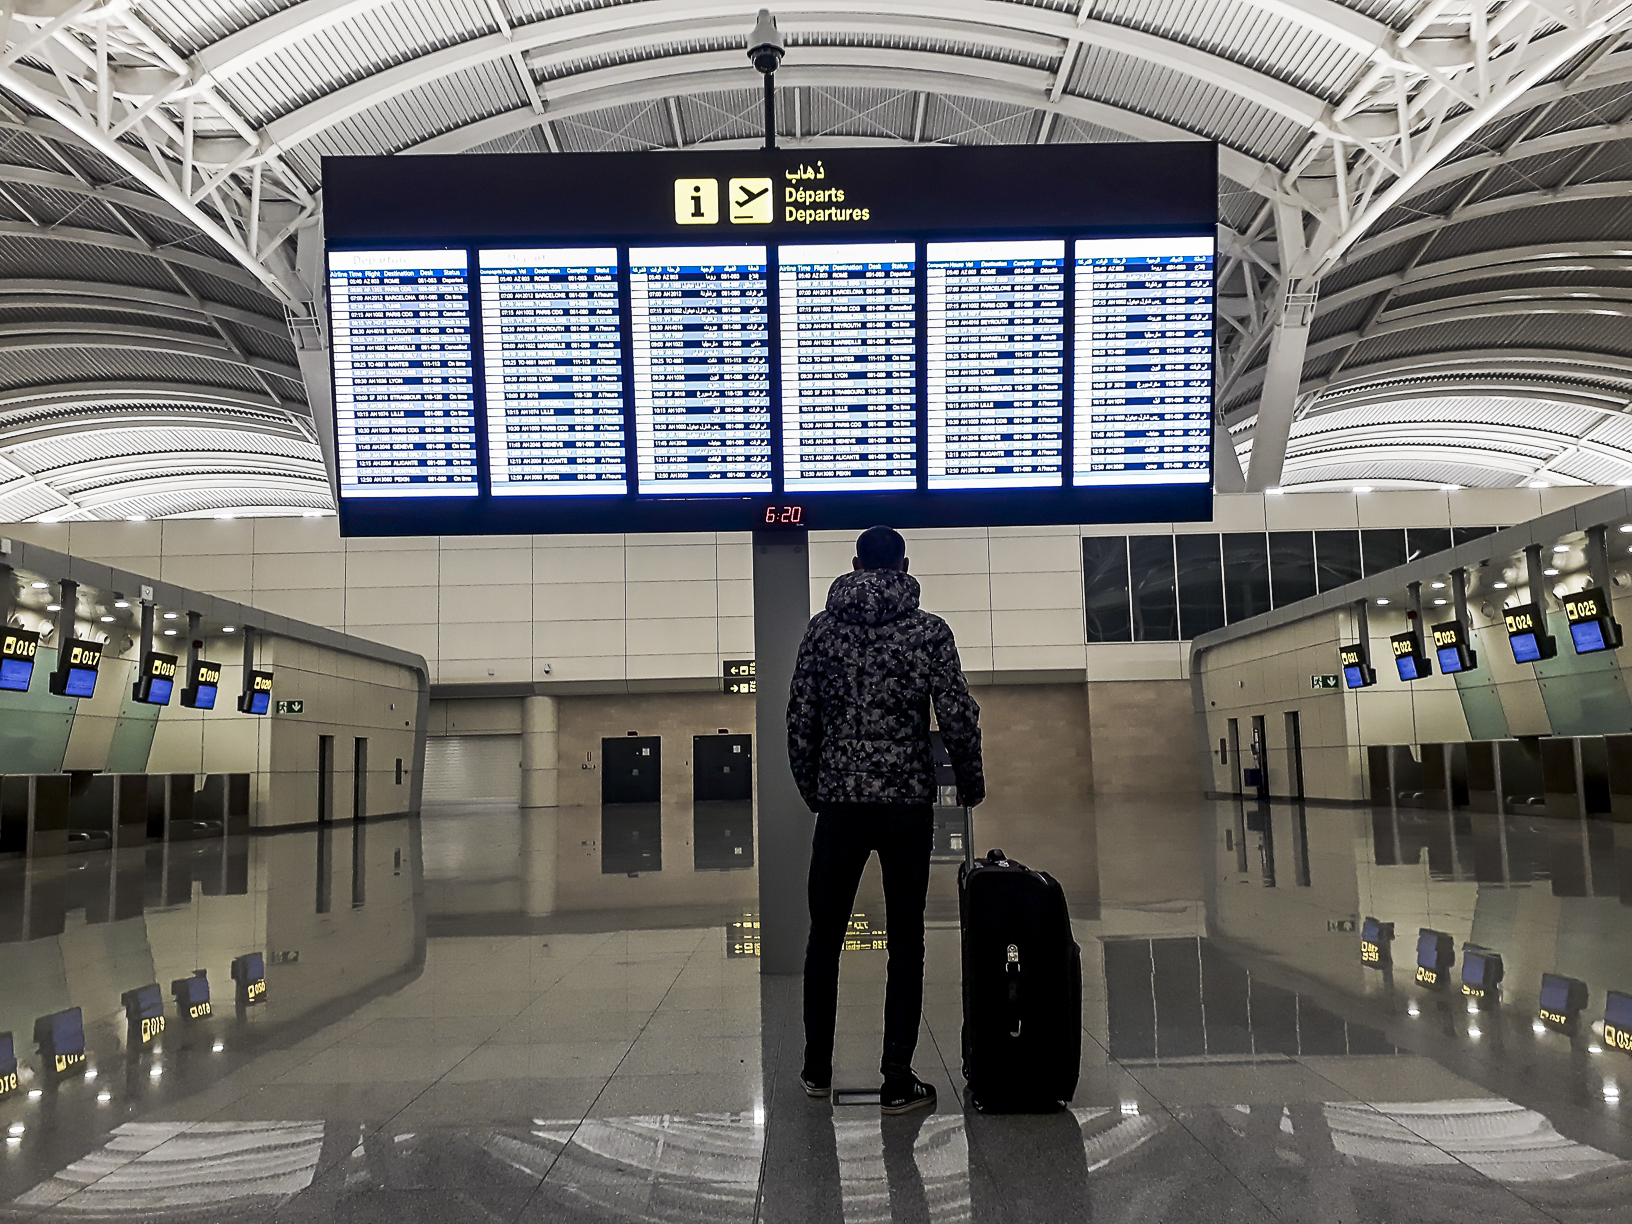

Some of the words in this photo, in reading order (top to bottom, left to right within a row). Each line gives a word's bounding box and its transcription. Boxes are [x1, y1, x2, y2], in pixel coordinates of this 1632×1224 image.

[785, 160, 825, 184] ذهاب
[785, 187, 845, 205] Départs
[785, 207, 870, 224] Departures
[364, 270, 381, 278] Flight
[779, 265, 797, 273] Airline
[798, 264, 811, 272] Time
[813, 264, 829, 273] Flight
[766, 507, 802, 522] 6:20
[1577, 600, 1597, 617] 025
[1515, 614, 1533, 629] 024
[1441, 630, 1456, 643] 023
[16, 640, 36, 656] 016
[1400, 640, 1412, 653] 022
[82, 650, 100, 665] 017
[1347, 652, 1358, 663] 021
[160, 663, 175, 676] 018
[206, 670, 219, 682] 019
[260, 679, 272, 690] 020
